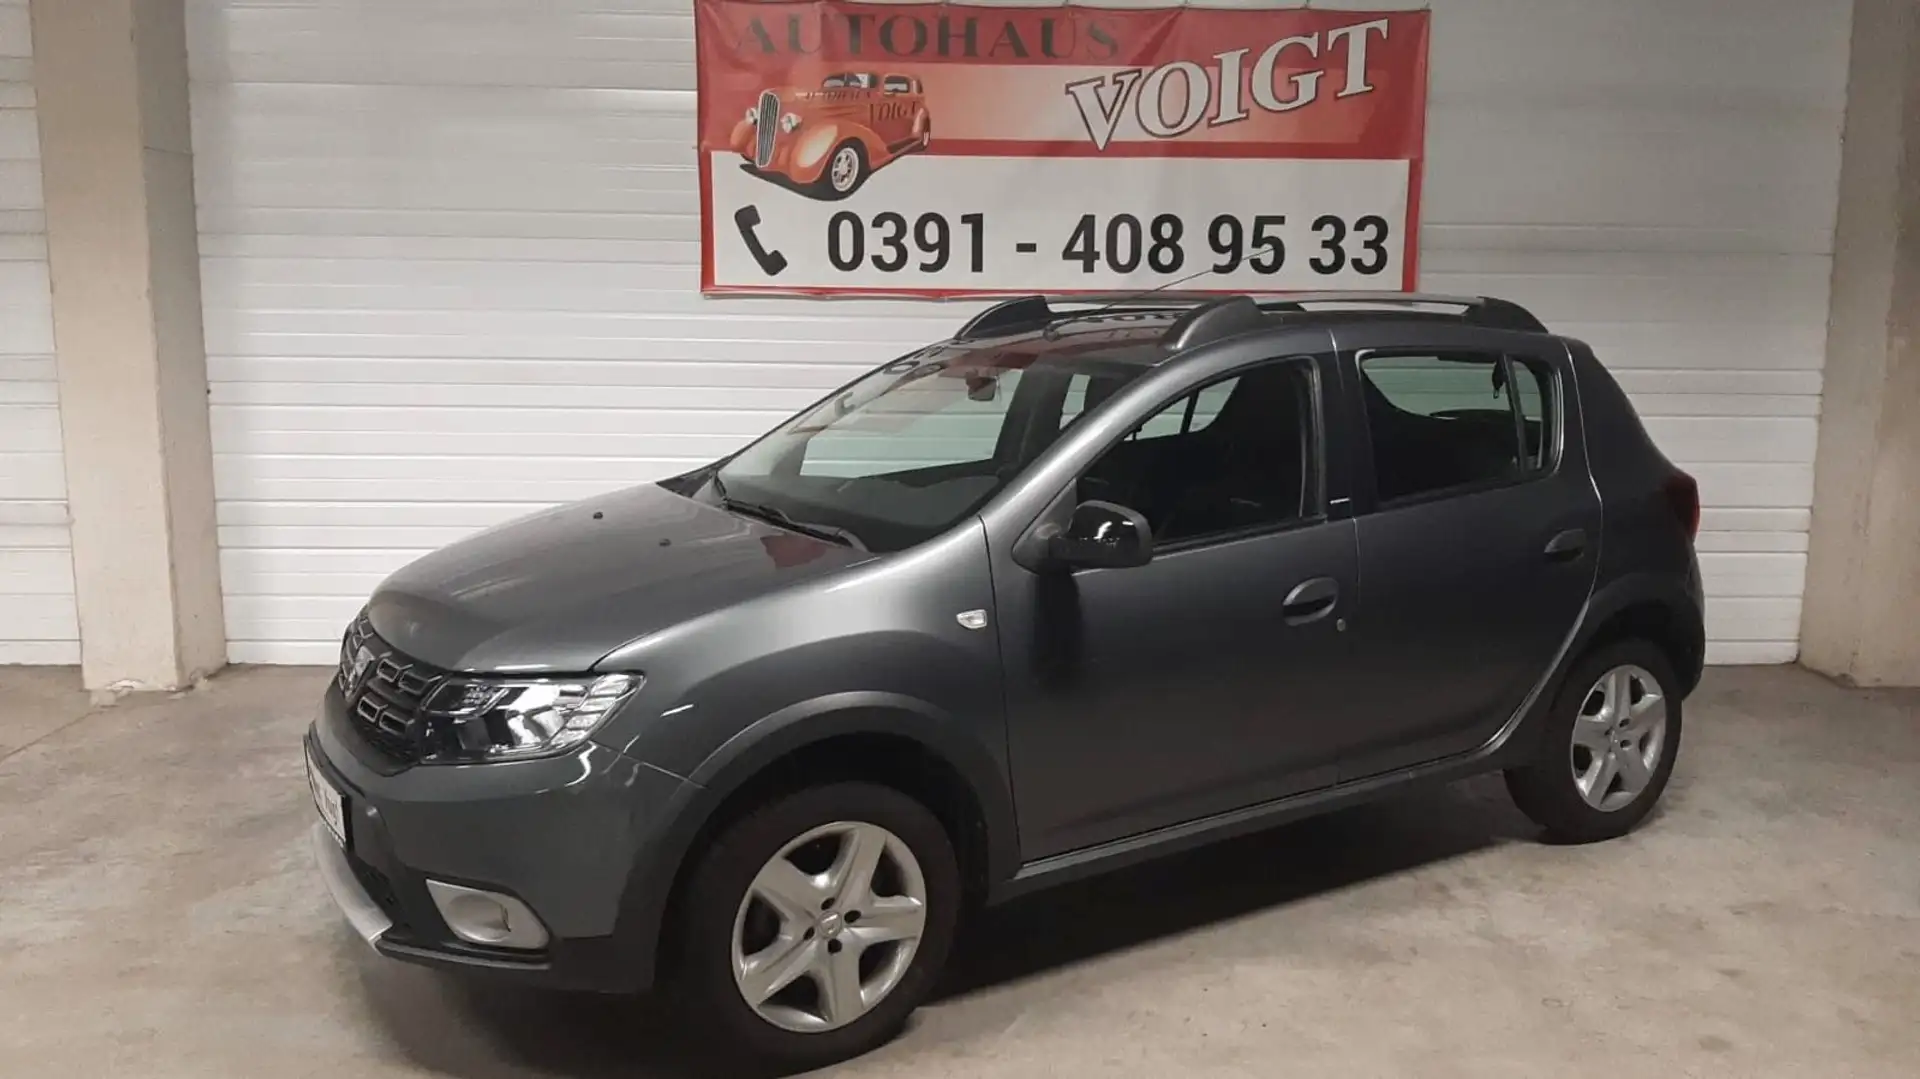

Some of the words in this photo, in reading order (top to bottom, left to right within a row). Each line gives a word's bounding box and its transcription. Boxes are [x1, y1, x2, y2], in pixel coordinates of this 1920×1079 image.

[737, 13, 1119, 60] AUTOHAUS
[1065, 18, 1390, 151] VOIGT
[828, 211, 986, 274] 0391
[1062, 213, 1184, 274] 408
[1208, 213, 1286, 275] 95
[1309, 214, 1389, 274] 33
